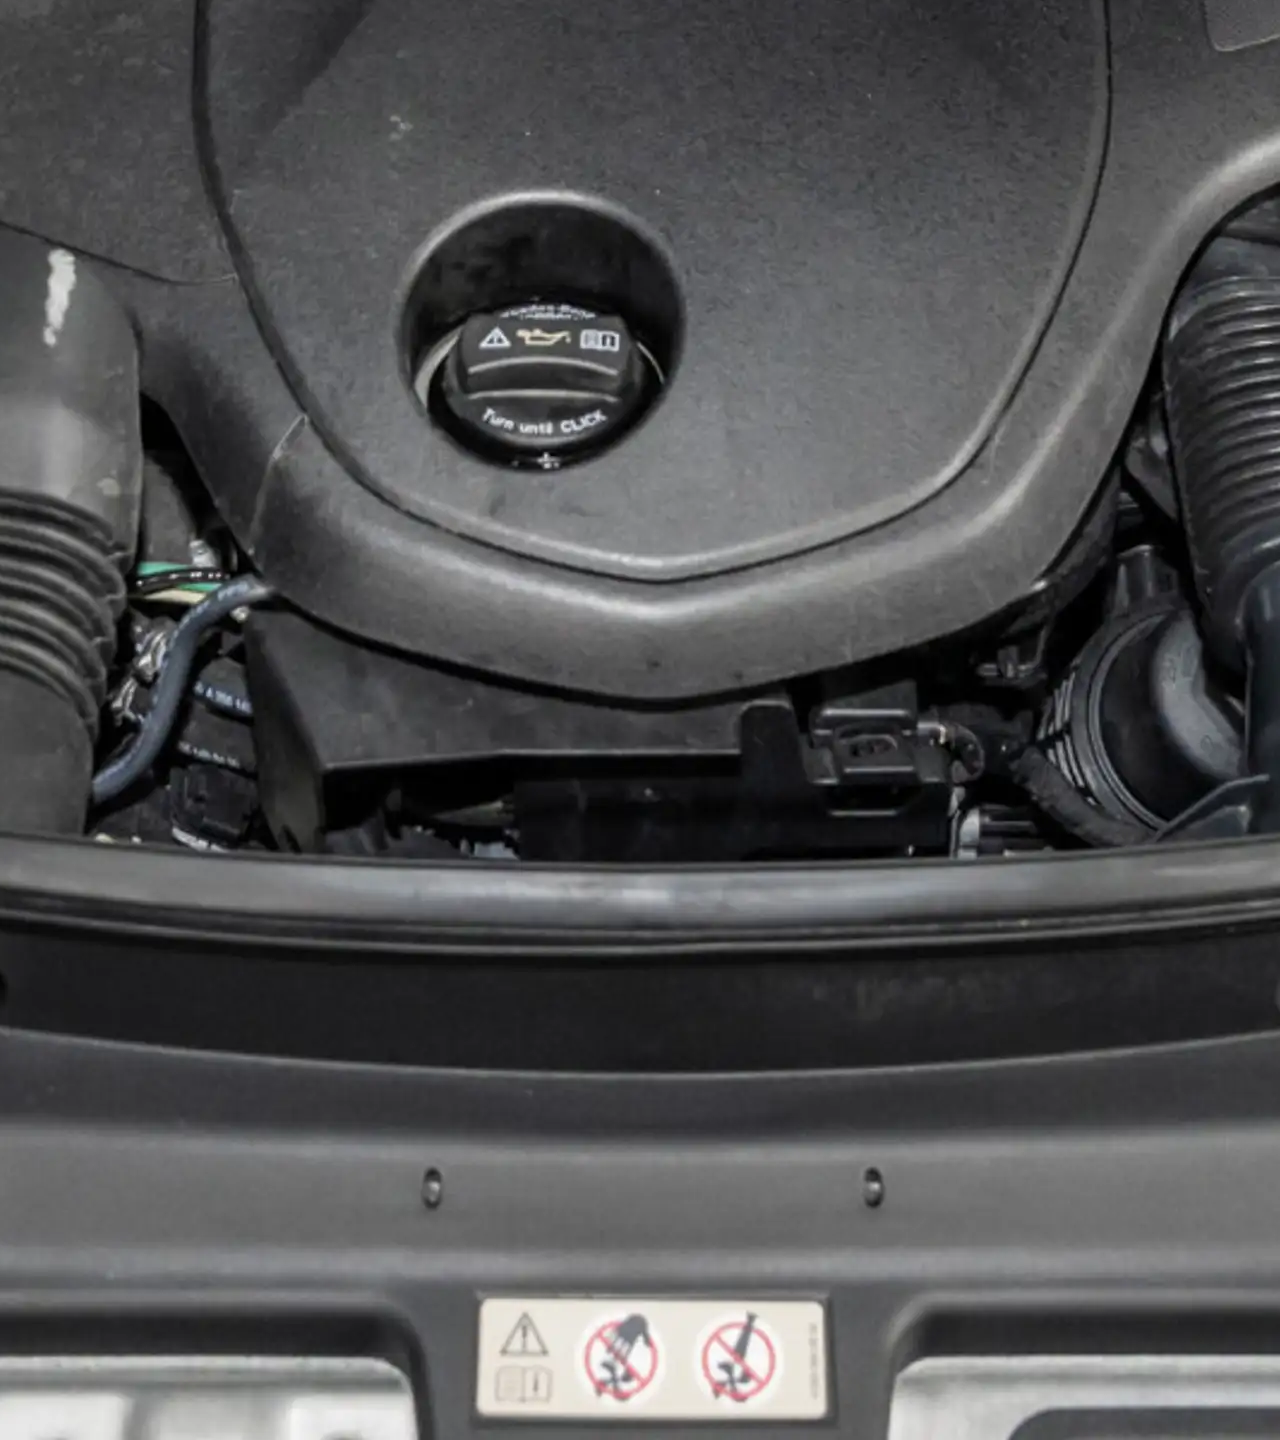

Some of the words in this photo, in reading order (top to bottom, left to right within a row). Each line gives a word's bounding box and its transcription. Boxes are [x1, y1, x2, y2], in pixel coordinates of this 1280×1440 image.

[483, 407, 514, 430] Turn
[520, 421, 553, 435] until
[560, 409, 607, 434] CLICK
